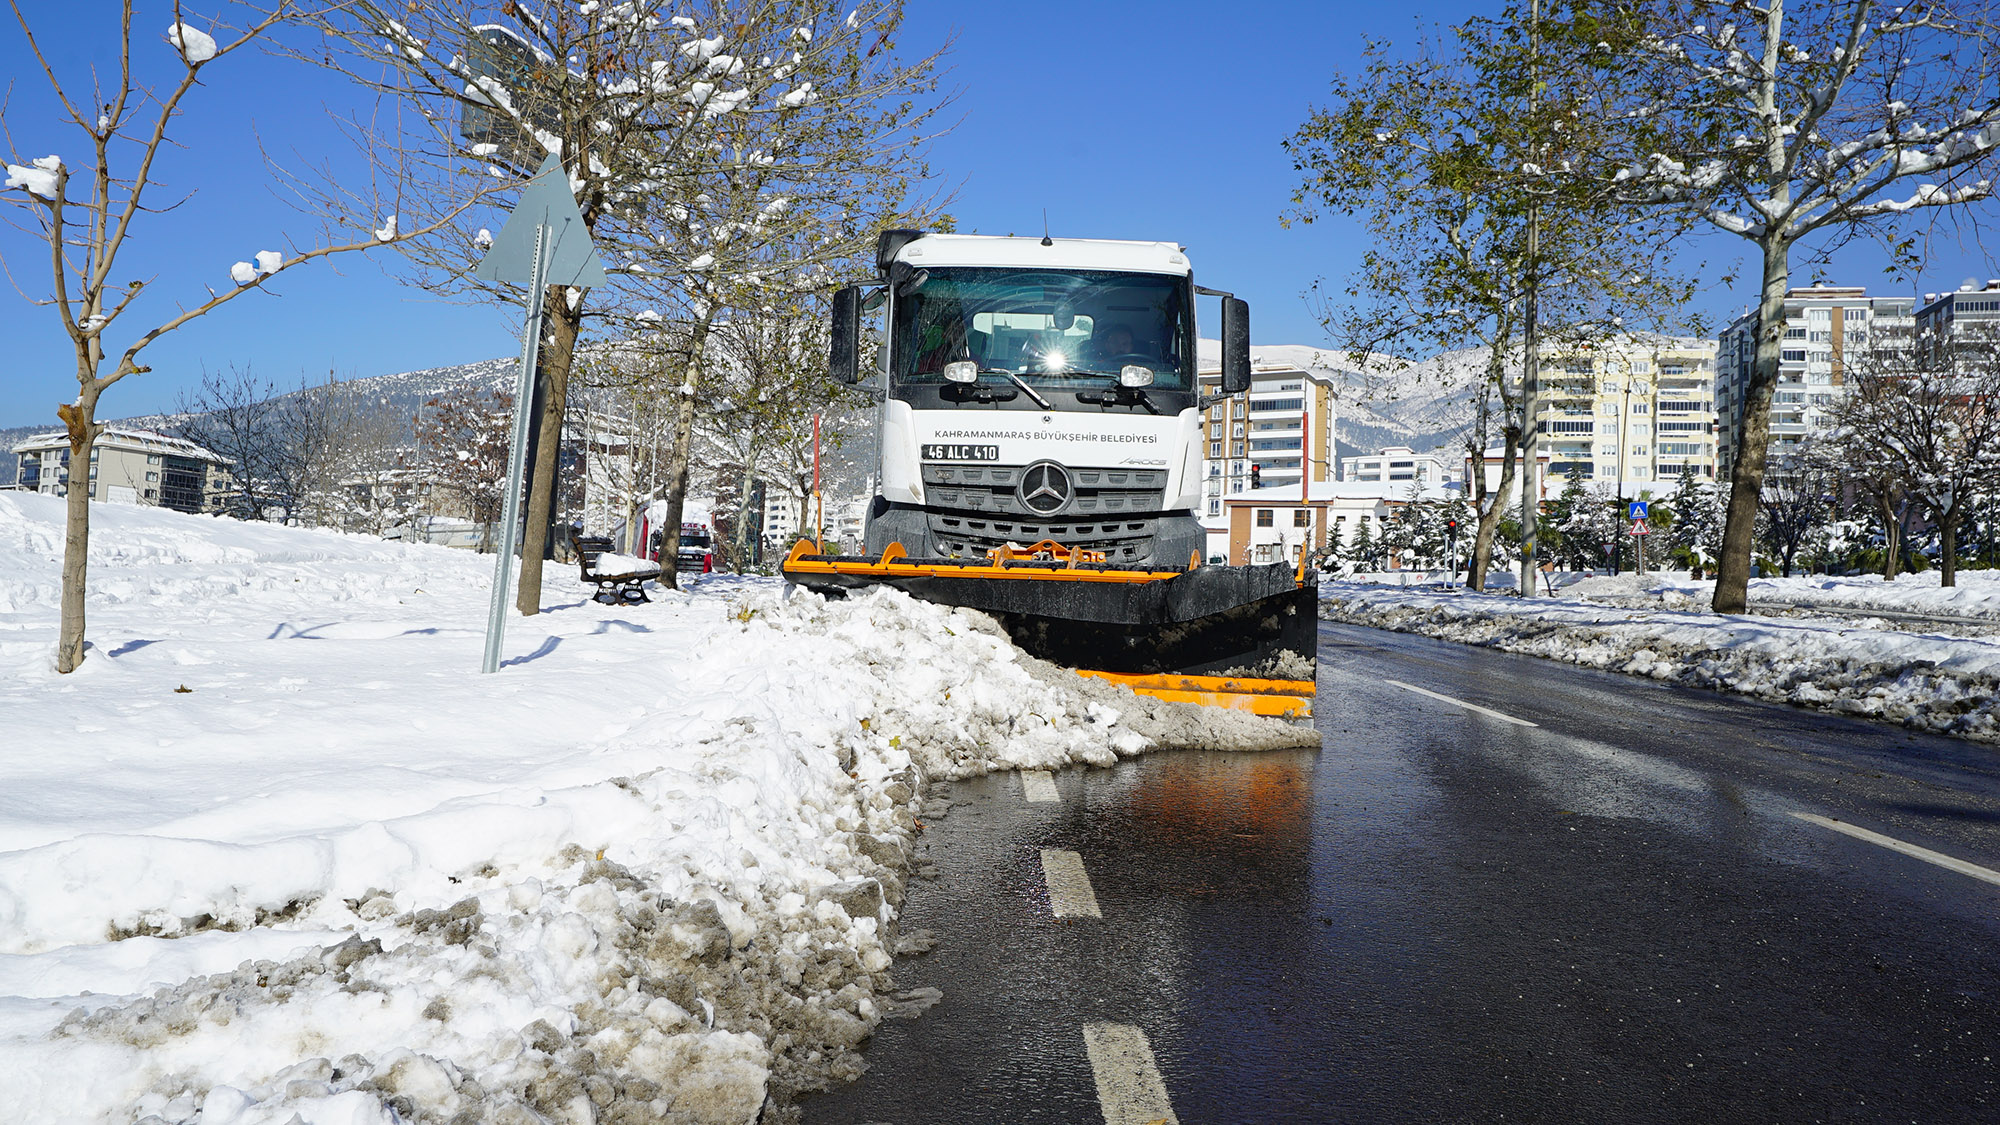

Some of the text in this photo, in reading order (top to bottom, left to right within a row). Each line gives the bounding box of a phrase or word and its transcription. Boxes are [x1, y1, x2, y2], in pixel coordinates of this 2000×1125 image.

[934, 430, 1157, 443] KAHRAMANMARAŞ BÜYÜKŞEHİR BELEDİYESİ
[928, 445, 996, 460] 46 ALC 410
